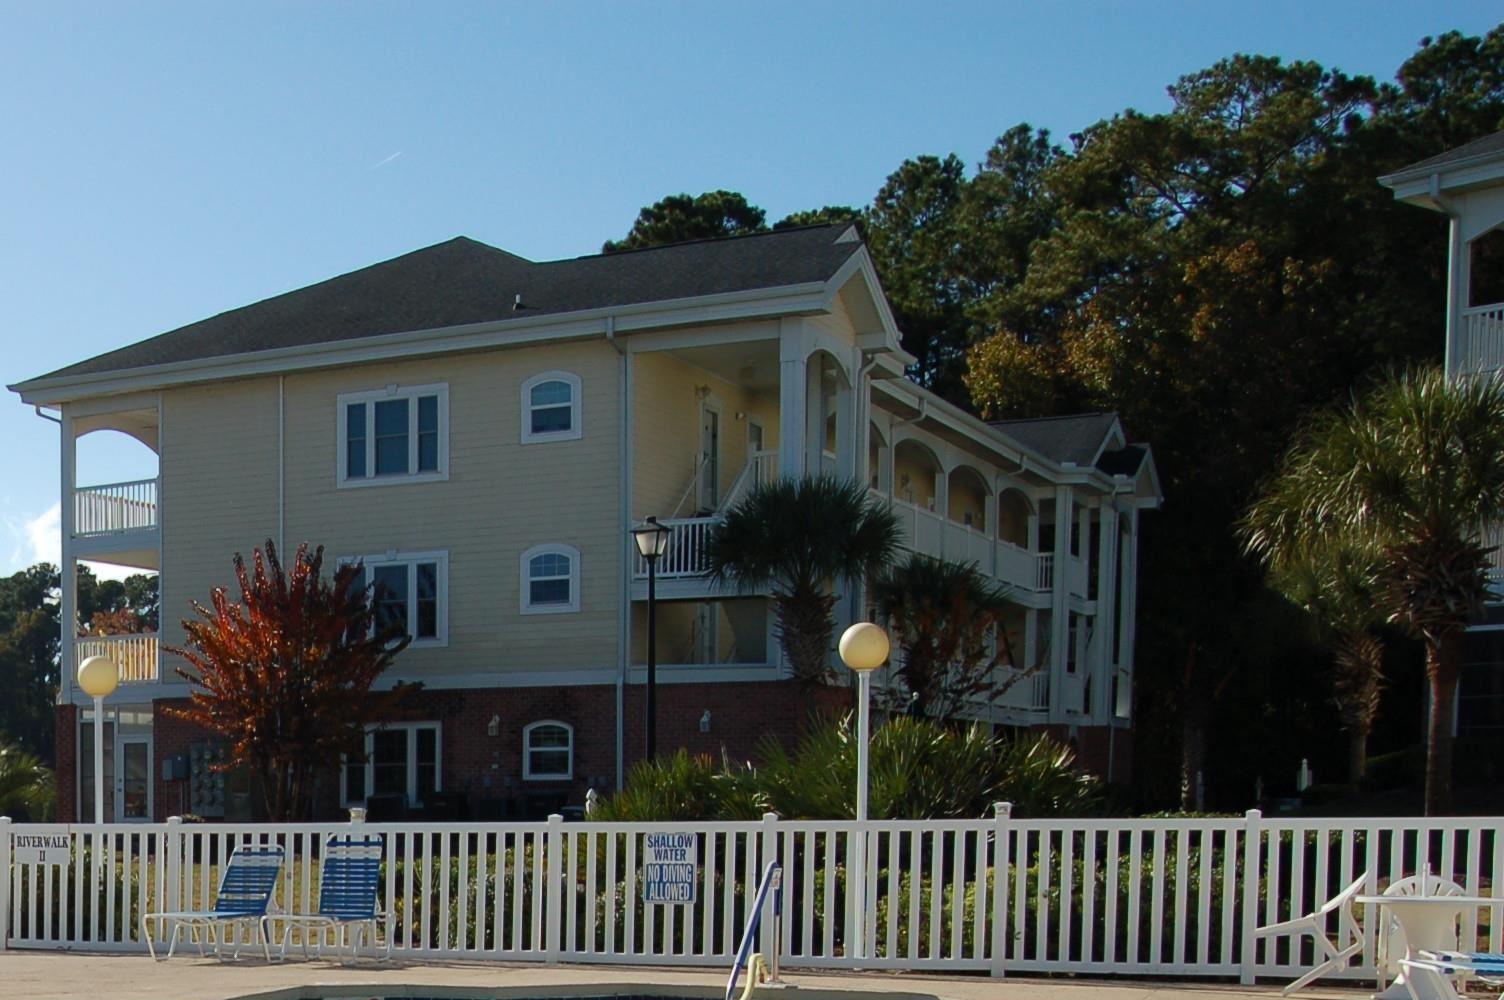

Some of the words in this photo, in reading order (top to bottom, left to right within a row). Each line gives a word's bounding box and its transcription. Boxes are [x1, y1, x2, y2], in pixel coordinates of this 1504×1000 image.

[16, 835, 69, 848] RIVERWALK
[647, 835, 693, 848] SHALLOW
[39, 850, 46, 862] II
[653, 849, 686, 861] WATER
[647, 864, 660, 883] NO
[662, 864, 692, 883] DIVING
[649, 883, 690, 901] ALLOWED
